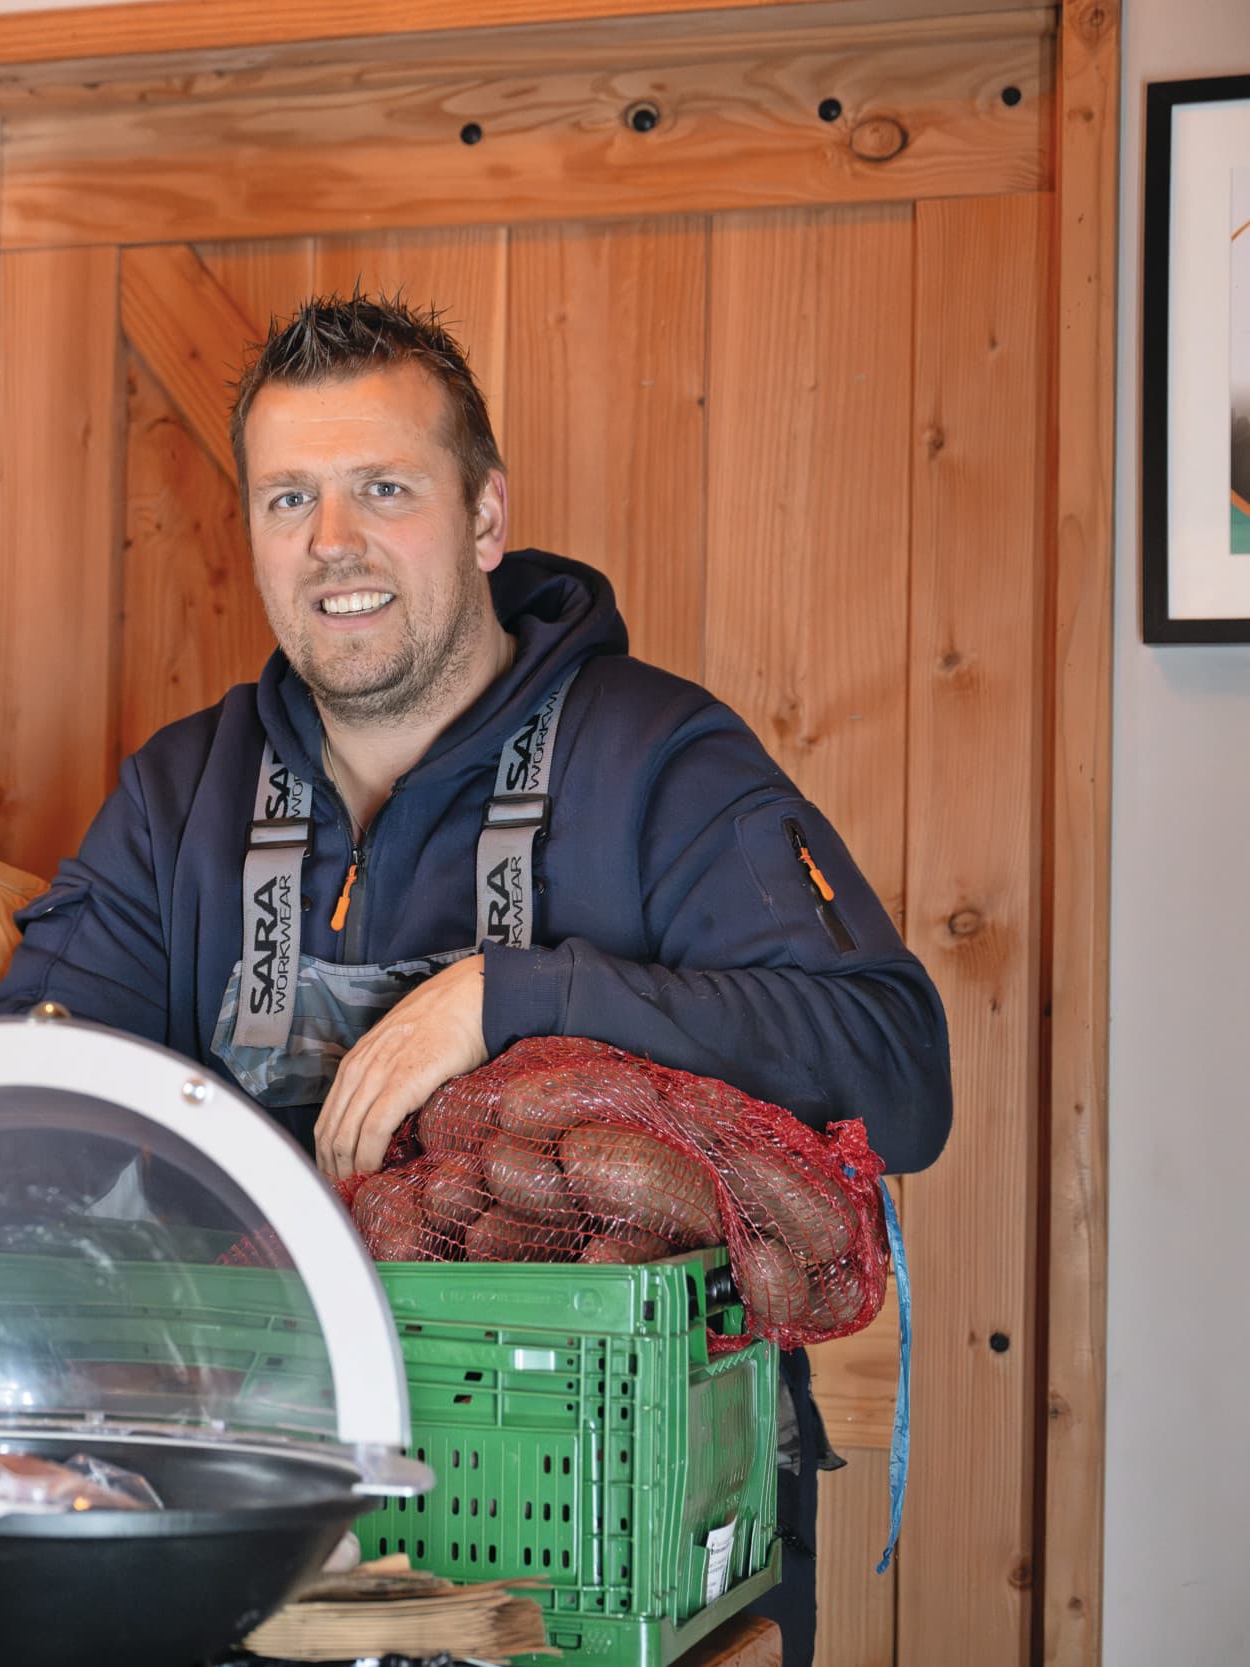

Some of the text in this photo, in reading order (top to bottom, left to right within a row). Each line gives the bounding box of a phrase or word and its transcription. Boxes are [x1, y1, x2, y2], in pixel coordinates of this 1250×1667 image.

[250, 876, 278, 1015] SARA
[274, 874, 292, 1014] WORKWEAR
[487, 857, 510, 946] RA
[511, 856, 523, 948] KWEAR
